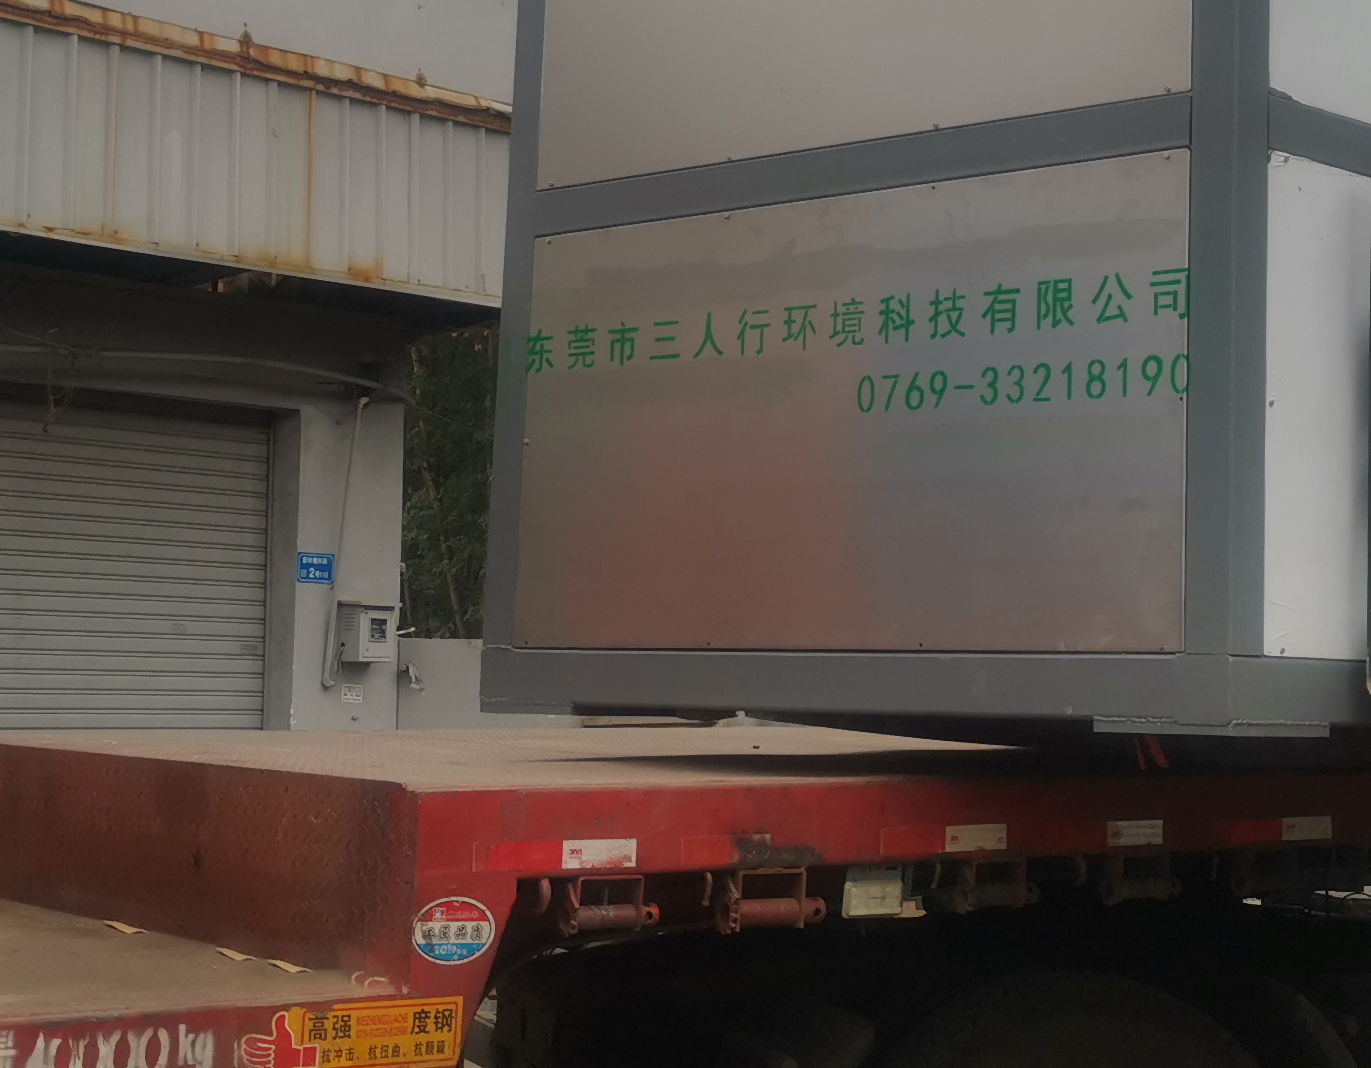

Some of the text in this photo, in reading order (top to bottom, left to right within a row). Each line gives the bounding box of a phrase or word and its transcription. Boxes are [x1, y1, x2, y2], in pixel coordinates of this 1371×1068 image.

[527, 267, 1190, 374] 东莞市三人行环境科技有限公司
[857, 352, 1190, 413] 0769-33218190
[308, 1014, 352, 1042] 高强
[410, 1008, 454, 1035] 度钢
